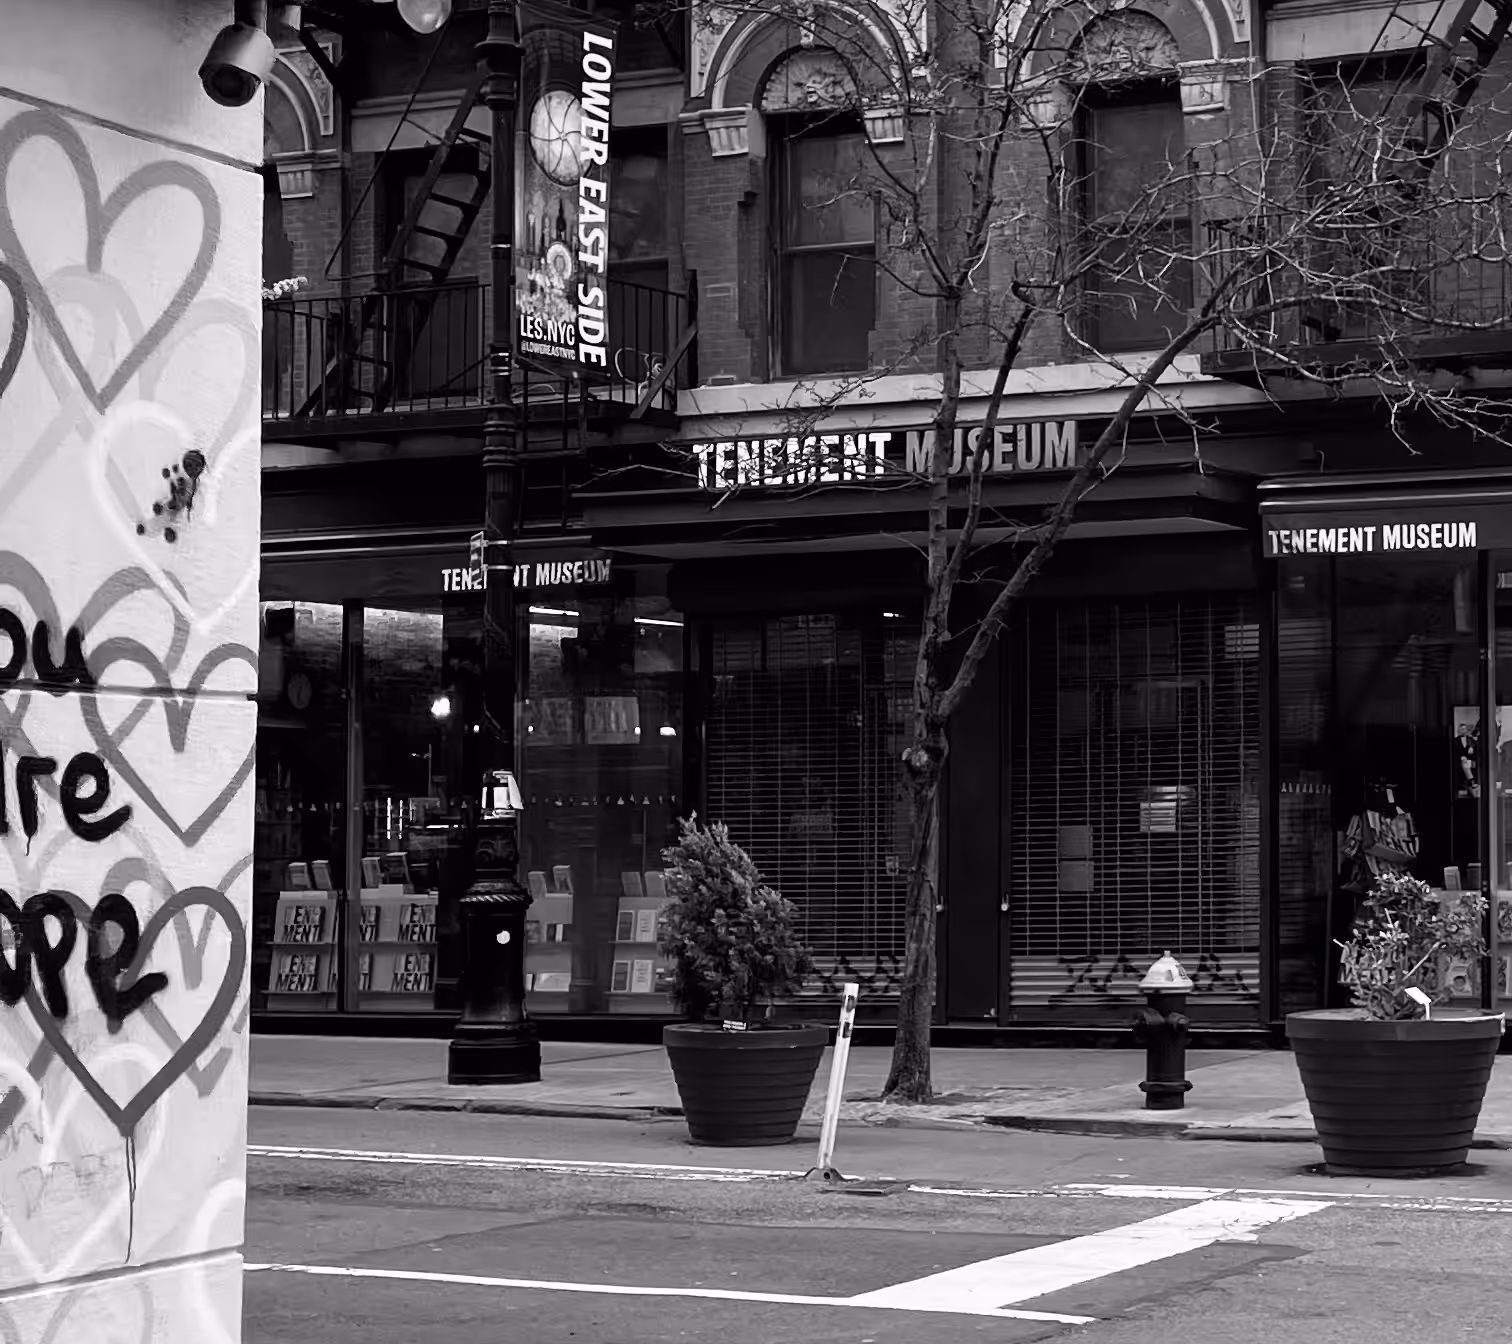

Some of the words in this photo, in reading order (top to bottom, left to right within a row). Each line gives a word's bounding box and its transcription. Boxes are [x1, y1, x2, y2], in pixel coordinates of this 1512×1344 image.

[579, 31, 613, 166] LOWER
[578, 176, 608, 273] EAST
[520, 314, 576, 346] LES.NYC
[578, 283, 607, 367] SIDE
[692, 432, 892, 489] TENEMENT
[535, 559, 612, 587] MUSEUM
[1268, 526, 1377, 555] TENEMENT
[1382, 521, 1478, 551] MUSEUM
[0, 739, 133, 856] re
